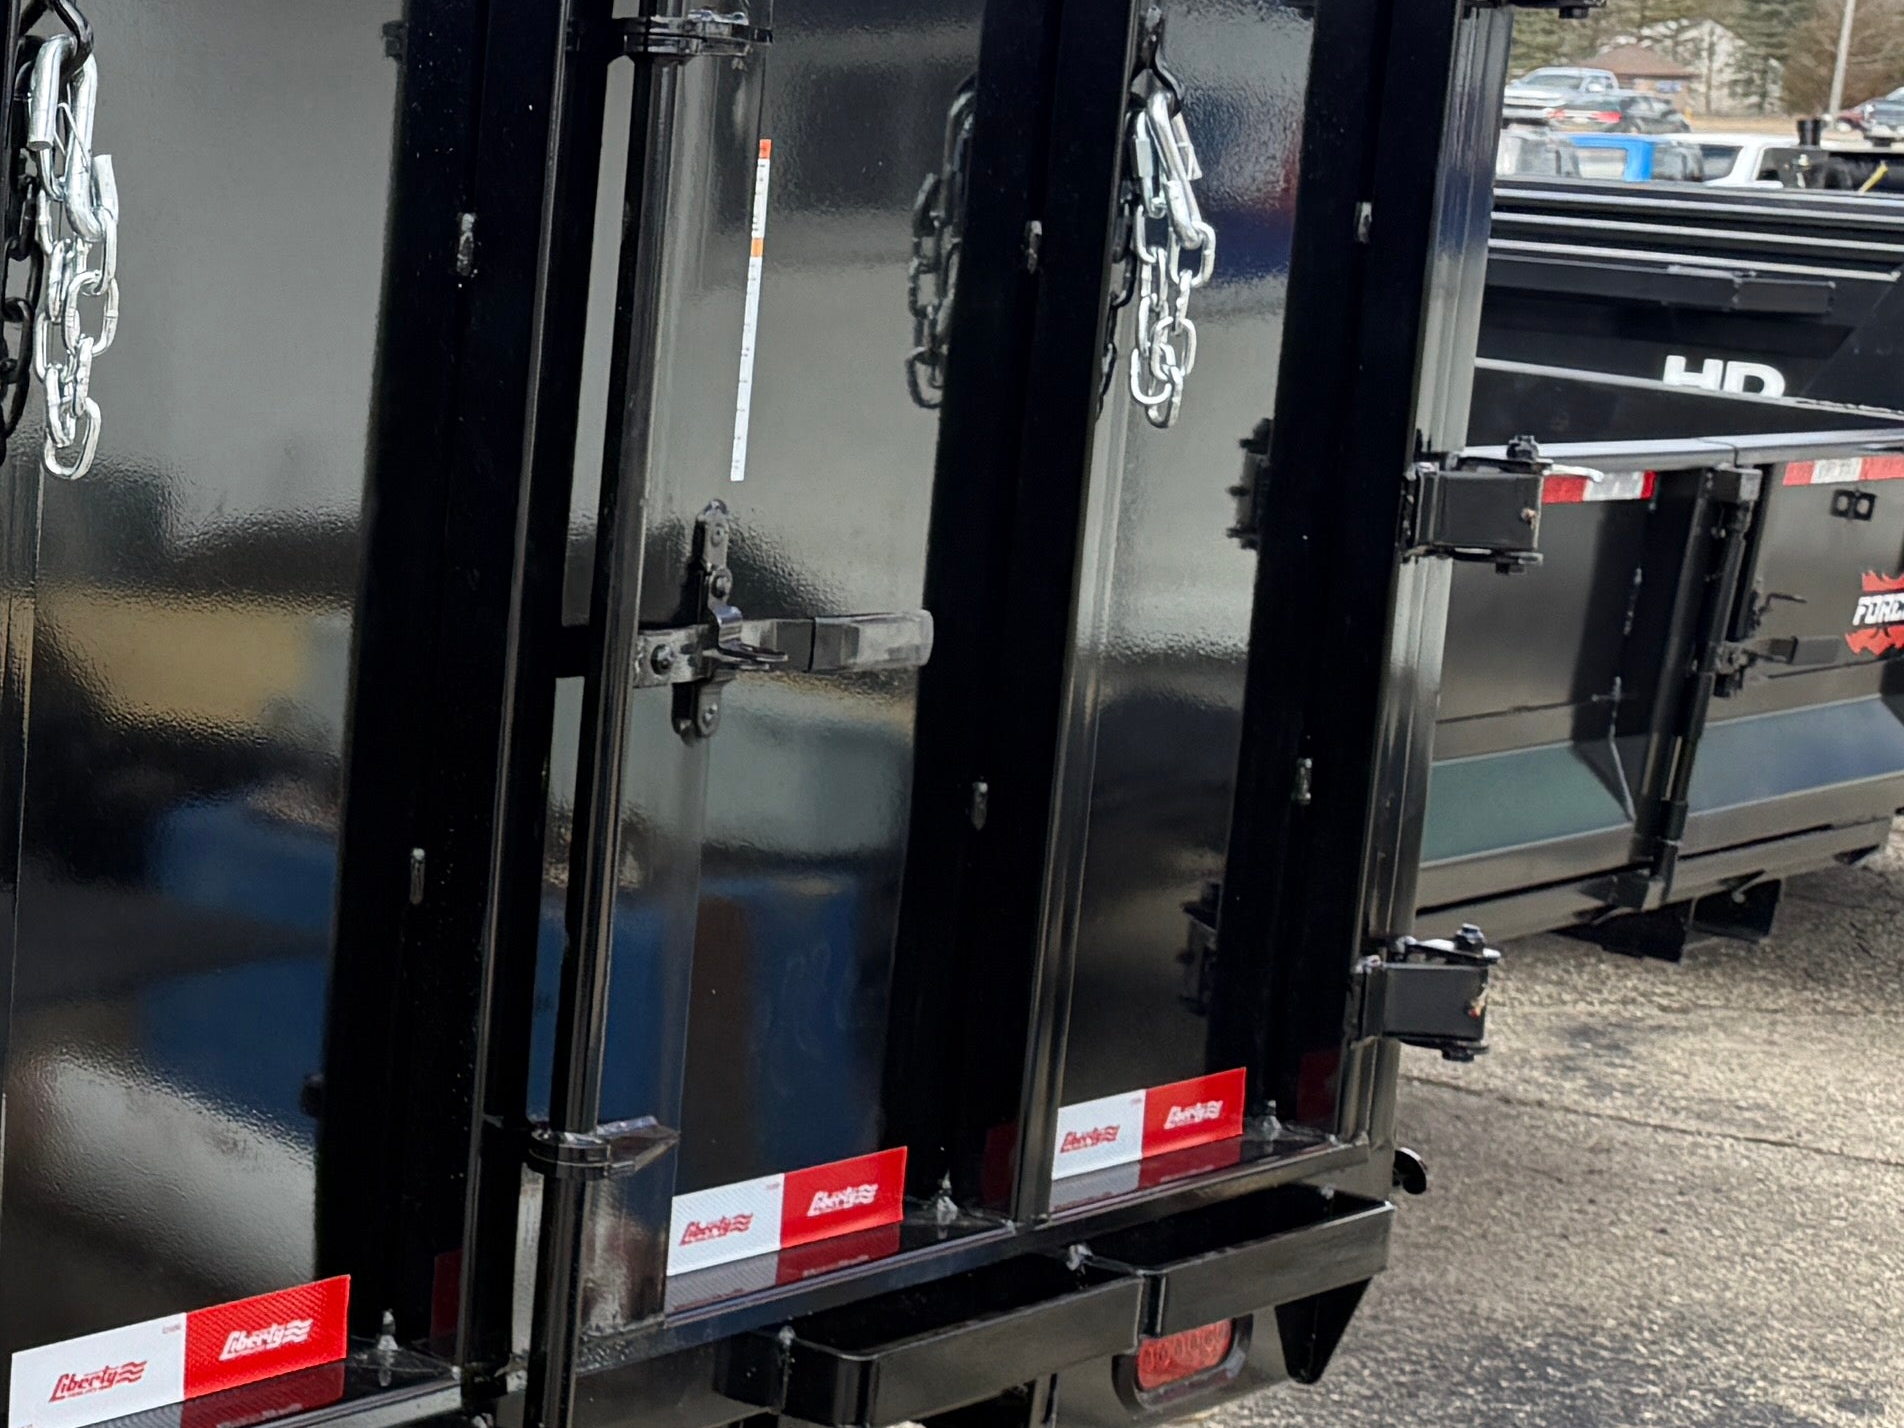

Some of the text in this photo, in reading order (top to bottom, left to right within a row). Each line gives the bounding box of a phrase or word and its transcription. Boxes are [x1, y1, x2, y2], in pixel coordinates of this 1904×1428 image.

[1663, 355, 1786, 398] HD
[218, 1324, 285, 1362] Liberty
[48, 1364, 118, 1403] Liberty
